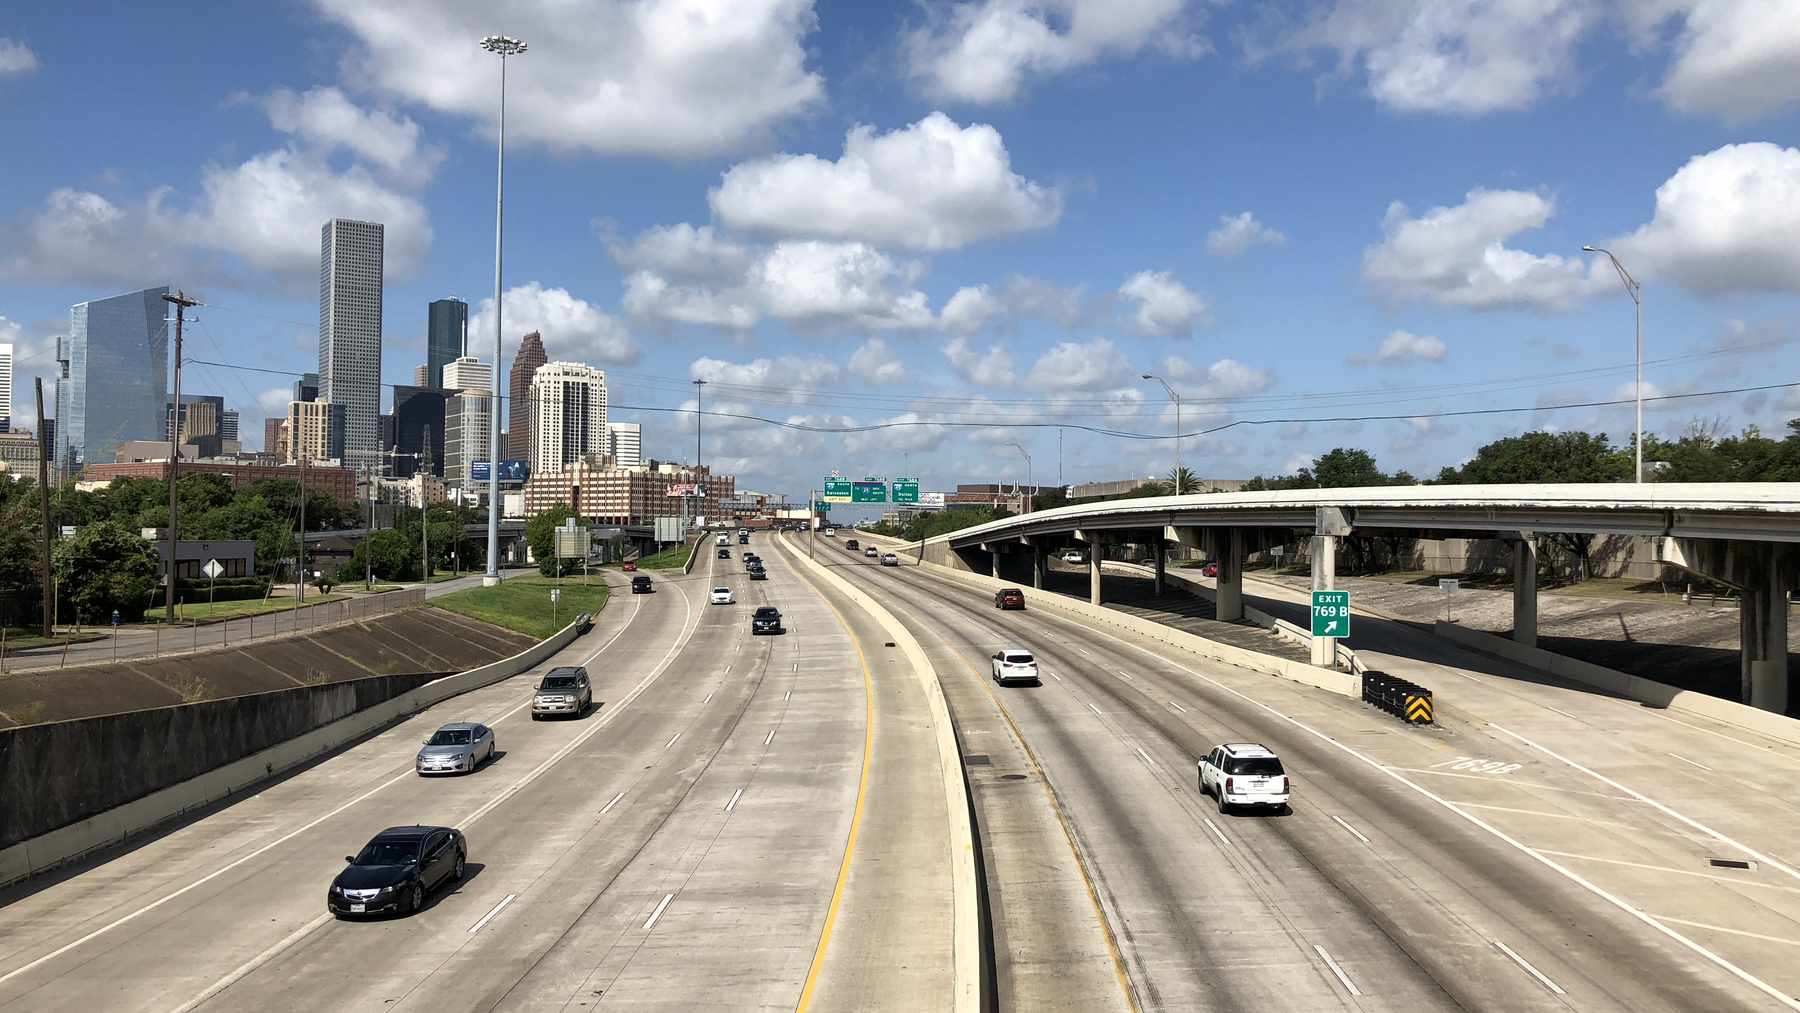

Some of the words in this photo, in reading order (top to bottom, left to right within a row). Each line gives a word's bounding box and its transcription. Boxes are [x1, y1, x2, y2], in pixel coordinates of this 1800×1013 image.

[1318, 595, 1343, 603] EXIT
[1313, 605, 1337, 617] 769
[1339, 606, 1348, 617] B
